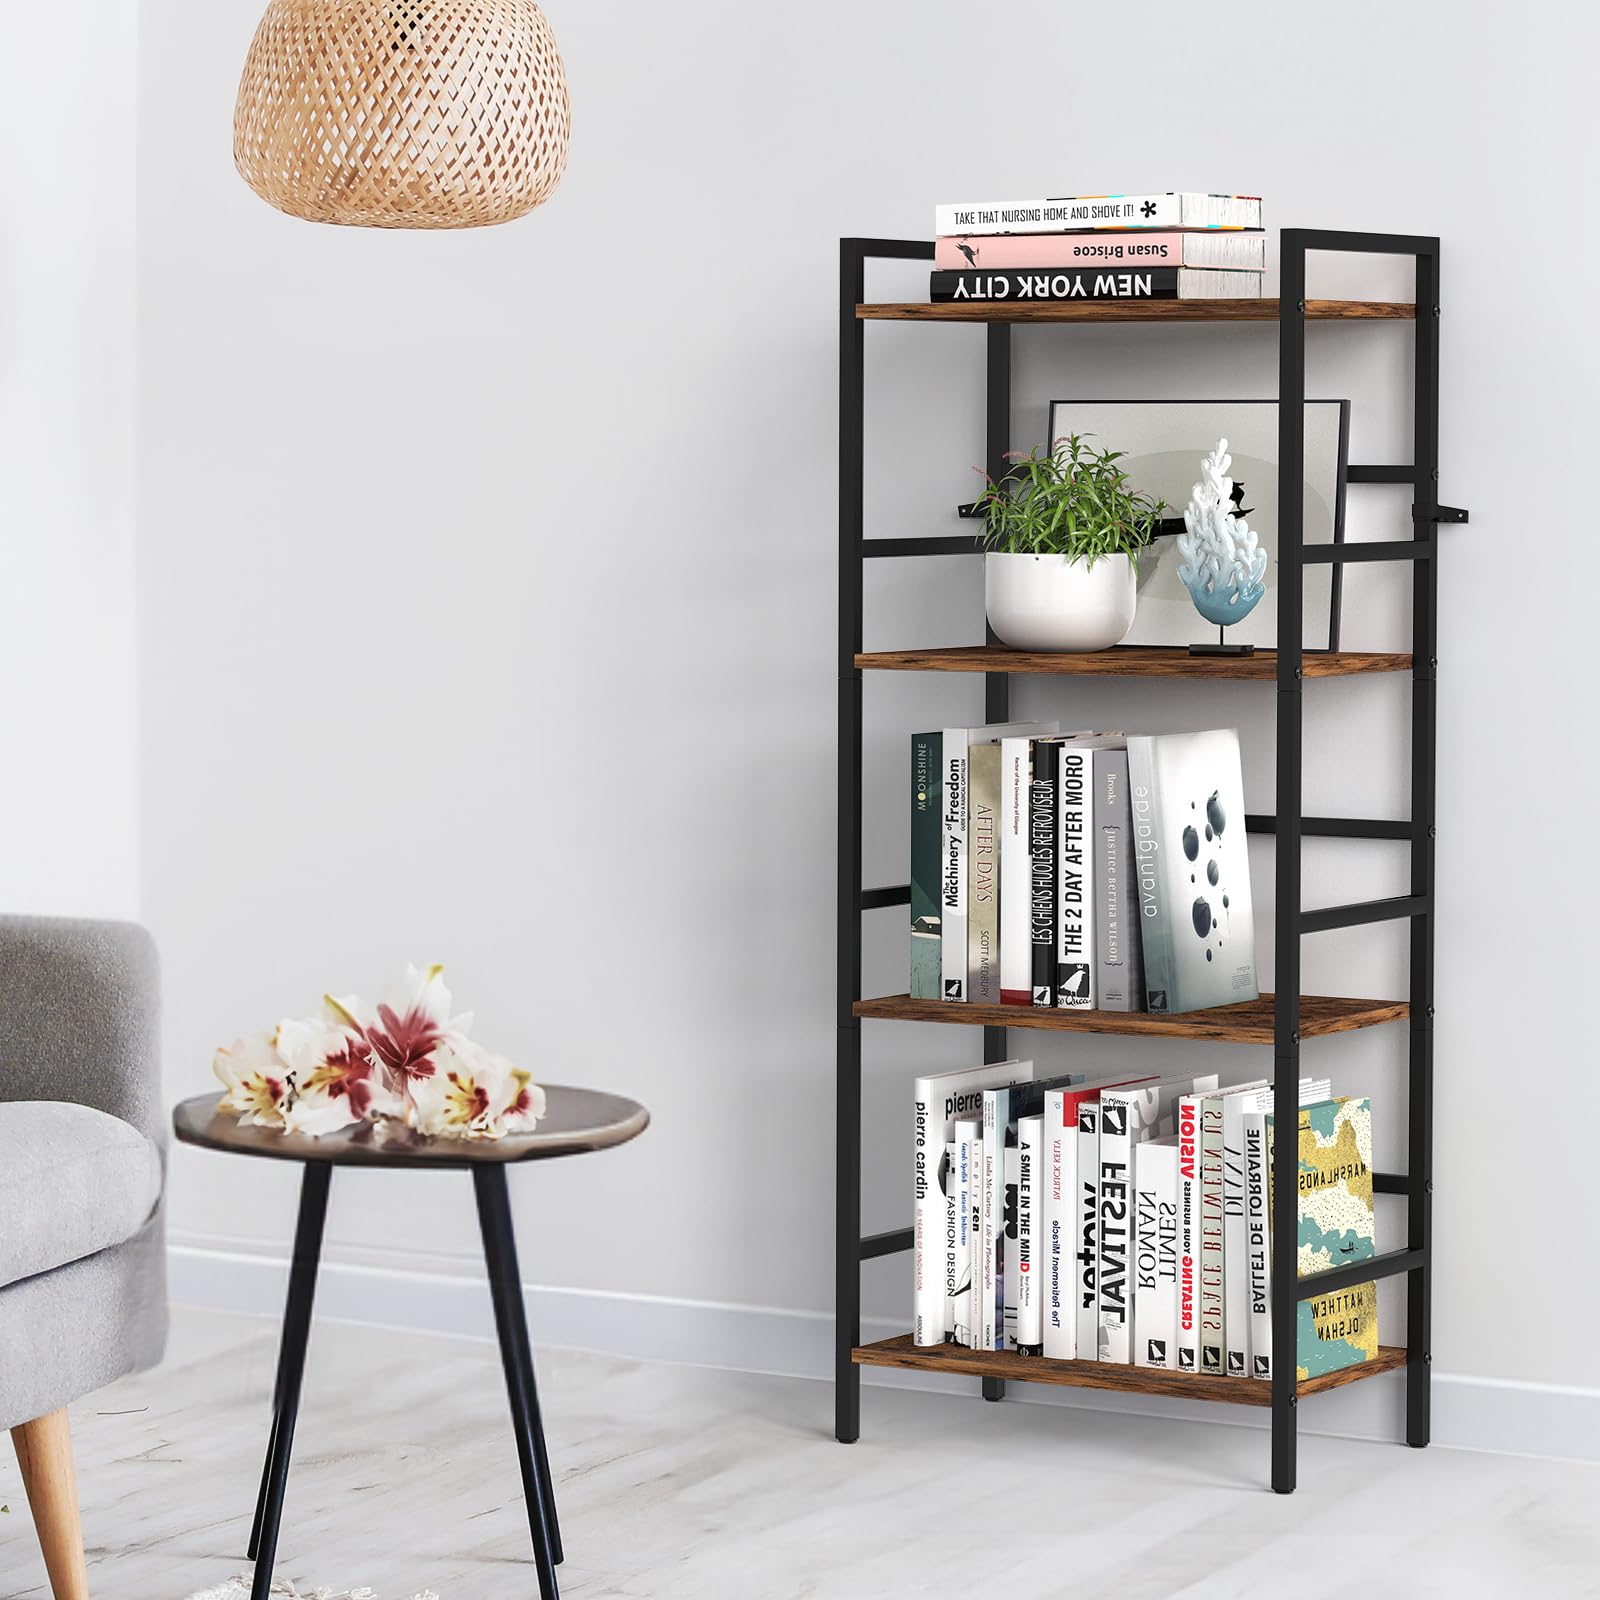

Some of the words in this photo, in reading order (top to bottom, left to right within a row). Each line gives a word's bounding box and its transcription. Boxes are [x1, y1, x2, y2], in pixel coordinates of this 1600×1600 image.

[954, 211, 976, 225] TAKE
[977, 210, 1000, 224] THAT
[1001, 208, 1041, 223] NURSING
[1043, 207, 1069, 221] HOME
[1071, 206, 1089, 220] AND
[1091, 205, 1122, 219] SHOVE
[1123, 204, 1134, 217] IT!
[1073, 245, 1124, 259] Briscoe
[1128, 245, 1168, 258] Susan
[953, 276, 1010, 298] CITY
[1017, 275, 1088, 298] YORK
[1093, 274, 1152, 296] NEW
[945, 759, 960, 823] Freedom
[1065, 755, 1083, 805] MORO
[1107, 773, 1117, 805] Brooks
[944, 823, 952, 831] of
[1031, 779, 1054, 846] RETROVISEUR
[977, 804, 993, 855] AFTER
[1065, 810, 1083, 865] AFTER
[1135, 785, 1158, 918] avantgarde
[945, 835, 962, 907] Machinery
[976, 861, 993, 902] DAYS
[1065, 870, 1082, 903] DAY
[1031, 890, 1053, 926] CHIENS
[1064, 908, 1082, 918] 2
[980, 930, 990, 956] SCOTT
[1031, 928, 1053, 945] LES
[1064, 924, 1082, 956] THE
[979, 957, 990, 997] MEDBURY
[945, 1091, 982, 1121] pierre
[915, 1101, 928, 1147] pierre
[1020, 1142, 1031, 1150] A
[916, 1152, 928, 1200] cardin
[1020, 1154, 1031, 1192] SMILE
[1020, 1196, 1031, 1209] IN
[946, 1196, 956, 1249] FASHION
[972, 1206, 980, 1232] zen
[1020, 1212, 1030, 1237] THE
[985, 1238, 992, 1246] in
[1020, 1240, 1030, 1273] MIND
[946, 1252, 956, 1297] DESIGN
